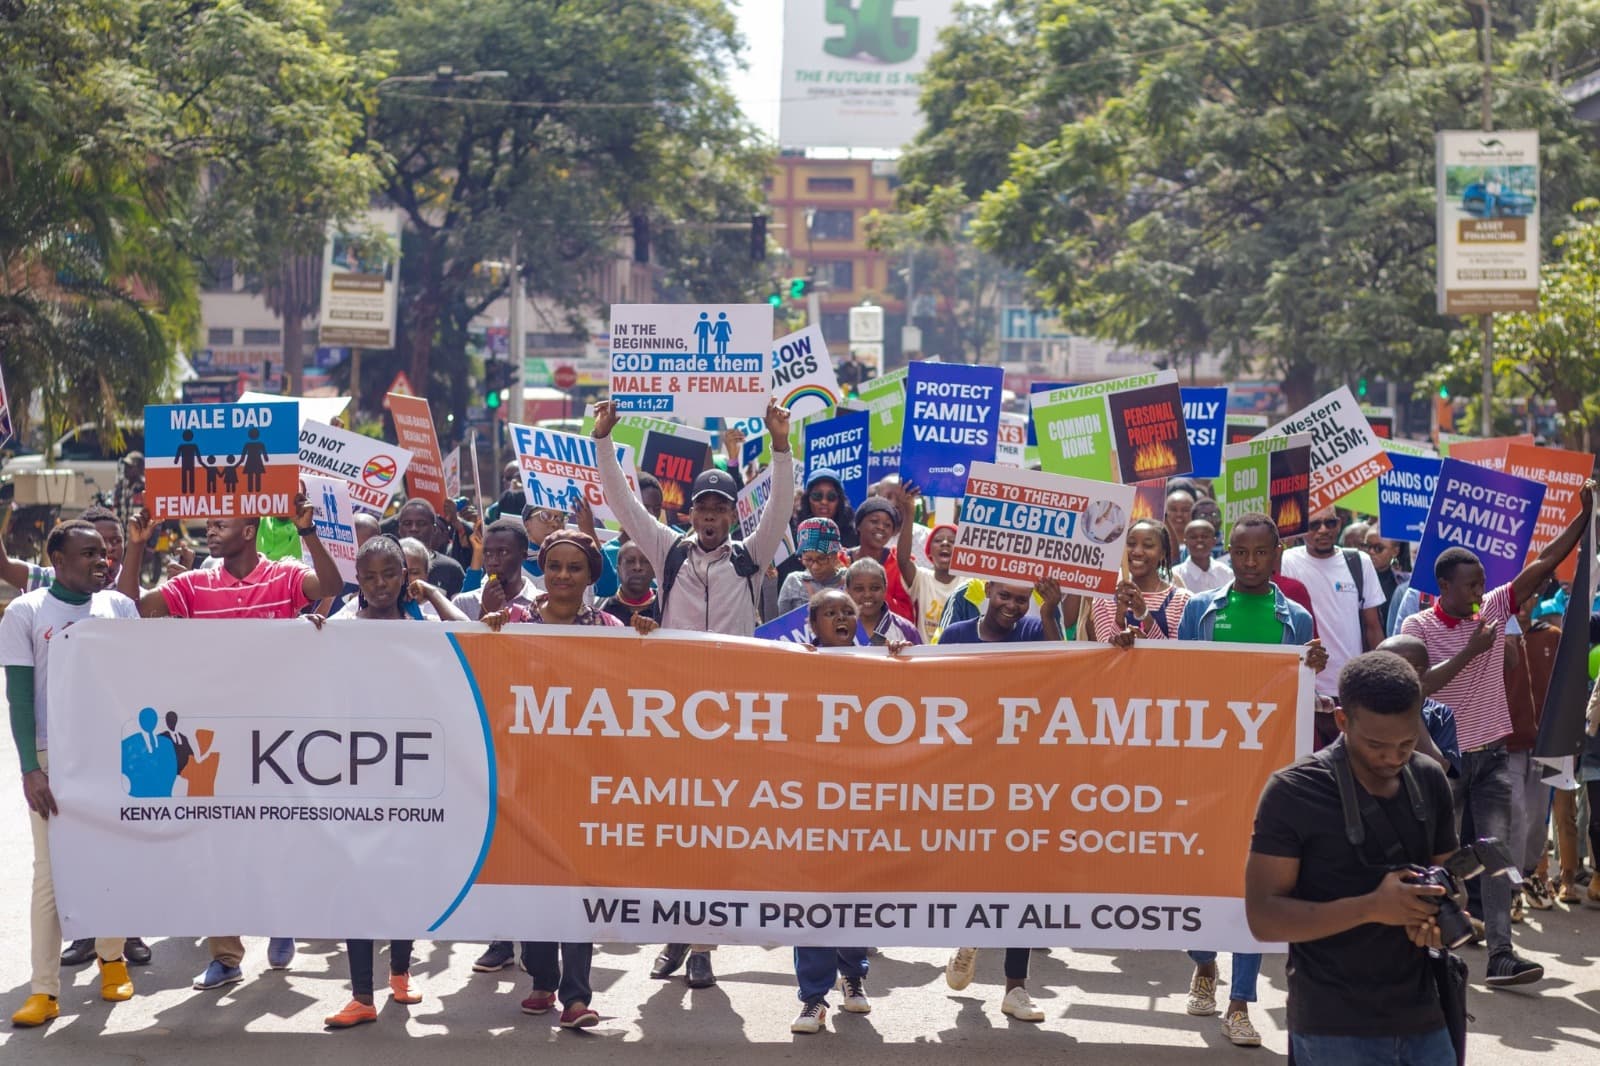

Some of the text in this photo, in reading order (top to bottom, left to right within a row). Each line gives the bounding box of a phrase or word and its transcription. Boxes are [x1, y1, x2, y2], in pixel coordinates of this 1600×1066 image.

[795, 70, 821, 82] THE
[827, 70, 881, 83] FUTURE
[886, 72, 900, 84] IS
[614, 324, 657, 336] IN THE
[613, 338, 688, 351] BEGINNING,
[613, 354, 759, 371] GOD made them
[612, 376, 764, 393] MALE & FEMALE.
[915, 381, 993, 400] PROTECT
[1049, 373, 1159, 403] ENVIRONMENT
[613, 399, 669, 411] Gen 1:1,27
[913, 401, 991, 423] FAMILY
[1123, 402, 1176, 427] PERSONAL
[1182, 402, 1220, 420] MILY
[170, 407, 273, 430] MALE DAD
[1048, 413, 1102, 441] COMMON
[1281, 400, 1342, 436] Western
[299, 430, 345, 454] DO NOT
[810, 427, 864, 451] PROTECT
[912, 425, 989, 446] VALUES
[1127, 420, 1179, 447] PROPERTY
[1186, 428, 1217, 446] RS!
[1249, 435, 1289, 456] TRUTH
[810, 444, 863, 471] FAMILY
[1061, 435, 1096, 459] HOME
[1311, 427, 1369, 473] ALISM;
[299, 448, 361, 478] ORMALIZE
[524, 459, 601, 482] AS CREATE
[655, 453, 694, 483] EVIL
[838, 465, 862, 482] UES
[1326, 464, 1342, 478] to
[1233, 468, 1258, 492] GOD
[1271, 473, 1309, 496] ATHEISM
[1322, 459, 1386, 498] VALUES.
[1380, 471, 1439, 491] HANDS OF
[1511, 465, 1584, 486] VALUE-BASED
[155, 495, 234, 517] FEMALE
[240, 494, 289, 515] MOM
[972, 480, 1087, 511] YES TO THERAPY
[1381, 490, 1434, 509] OUR FAMIL
[1446, 479, 1531, 513] PROTECT
[1544, 487, 1574, 503] ALITY
[966, 497, 1071, 538] for LGBTQ
[1226, 496, 1265, 522] EXISTS
[1440, 498, 1525, 537] FAMILY
[1540, 505, 1567, 522] TITY,
[316, 524, 353, 542] made them
[1437, 521, 1519, 559] VALUES
[959, 526, 1105, 569] AFFECTED PERSONS;
[956, 551, 1102, 589] NO TO LGBTQ Ideology
[508, 684, 1278, 751] MARCH FOR FAMILY
[251, 729, 433, 786] KCPF
[589, 776, 740, 808] FAMILY
[749, 780, 804, 810] AS
[817, 782, 995, 812] DEFINED
[1008, 783, 1061, 812] BY
[1070, 784, 1163, 814] GOD
[120, 805, 445, 822] KENYA CHRISTIAN PROFESSIONALS FORUM
[579, 821, 1205, 856] THE FUNDAMENTAL UNIT OF SOCIETY.
[582, 898, 1202, 932] WE MUST PROTECT IT AT ALL COSTS
